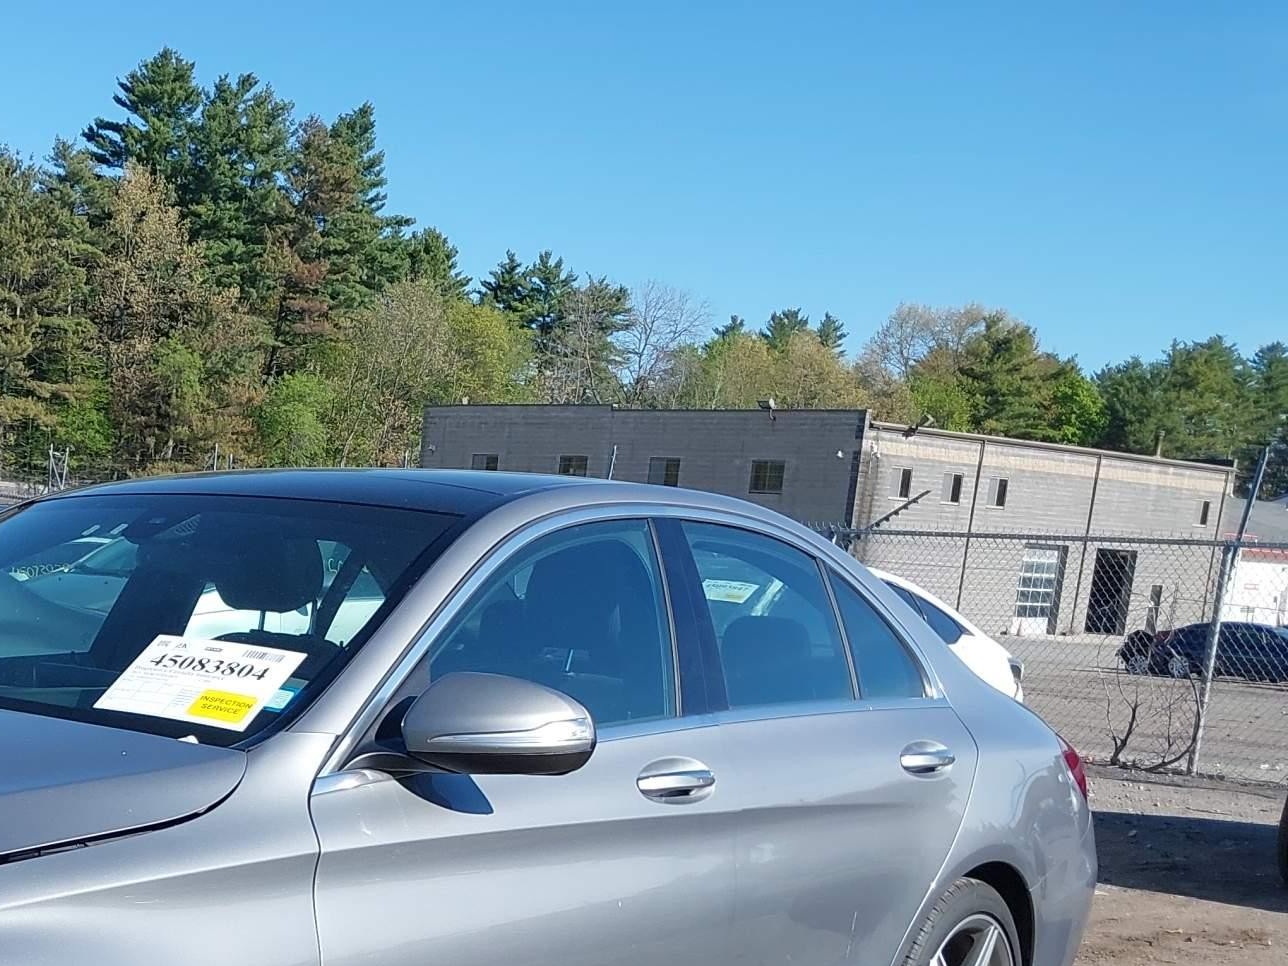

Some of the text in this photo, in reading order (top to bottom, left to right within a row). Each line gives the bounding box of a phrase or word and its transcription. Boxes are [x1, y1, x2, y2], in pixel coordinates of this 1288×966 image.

[150, 653, 270, 680] 45083804
[200, 695, 253, 709] INSPECTION
[201, 703, 241, 715] SERVICE
